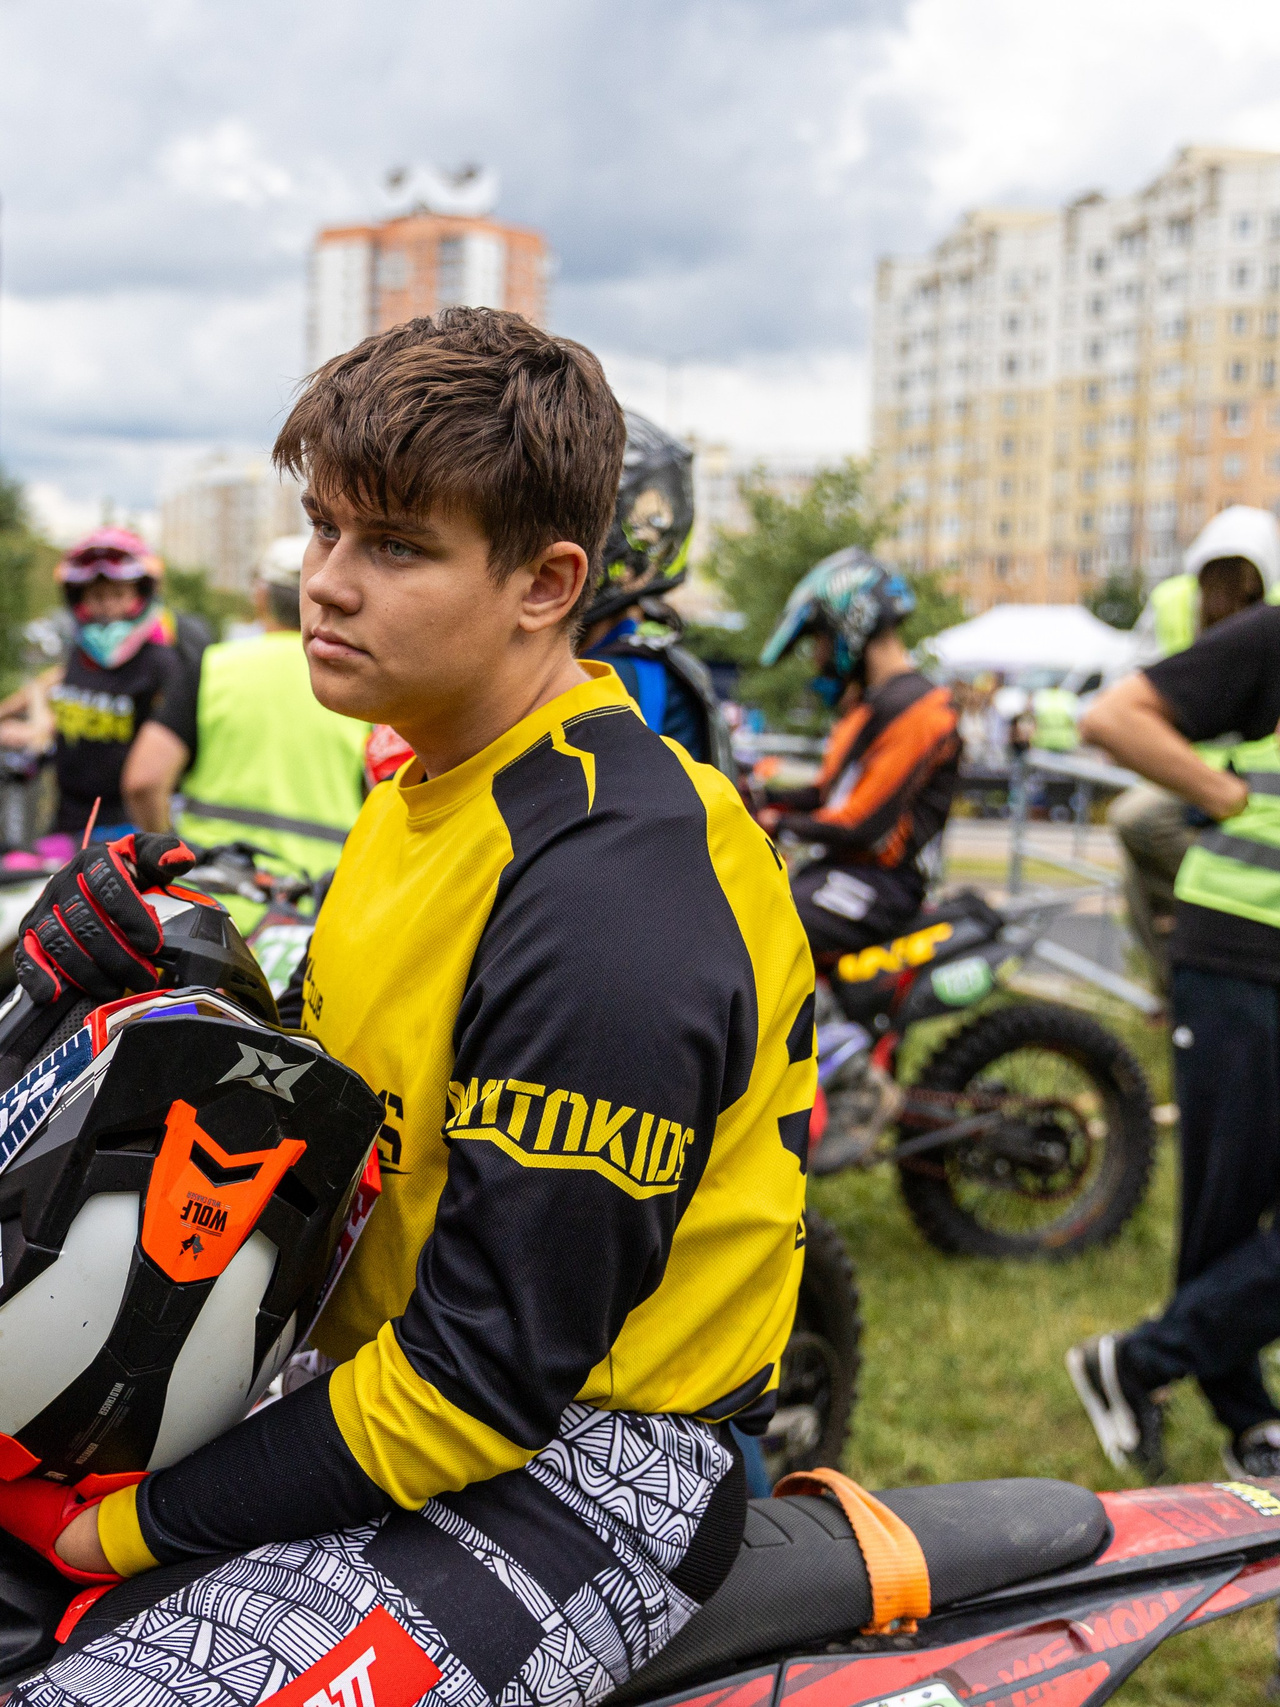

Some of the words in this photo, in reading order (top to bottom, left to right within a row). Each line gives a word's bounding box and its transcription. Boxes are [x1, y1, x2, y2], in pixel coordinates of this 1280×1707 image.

[187, 1191, 208, 1204] CHASER
[207, 1197, 221, 1208] WILD
[180, 1200, 228, 1232] WOLF
[110, 1382, 125, 1397] WILD
[98, 1395, 117, 1416] CHASER
